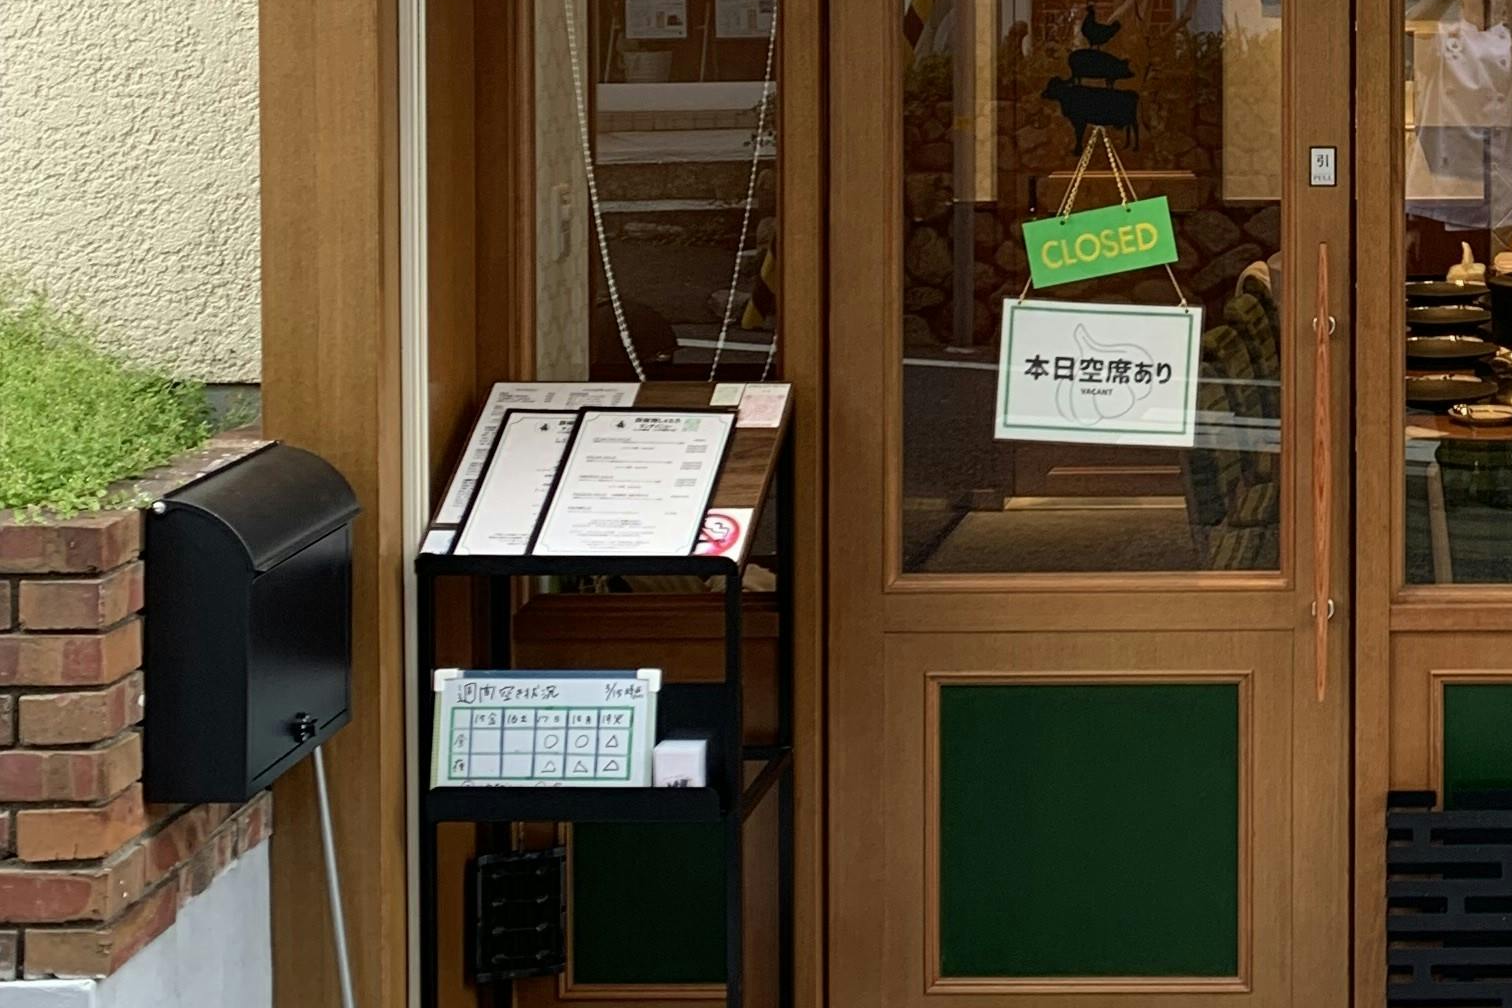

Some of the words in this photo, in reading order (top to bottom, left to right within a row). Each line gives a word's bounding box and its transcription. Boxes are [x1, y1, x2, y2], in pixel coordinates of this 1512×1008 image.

[1041, 222, 1159, 270] CLOSED
[1023, 353, 1173, 385] 本日空席あり
[1080, 387, 1114, 397] VACANT
